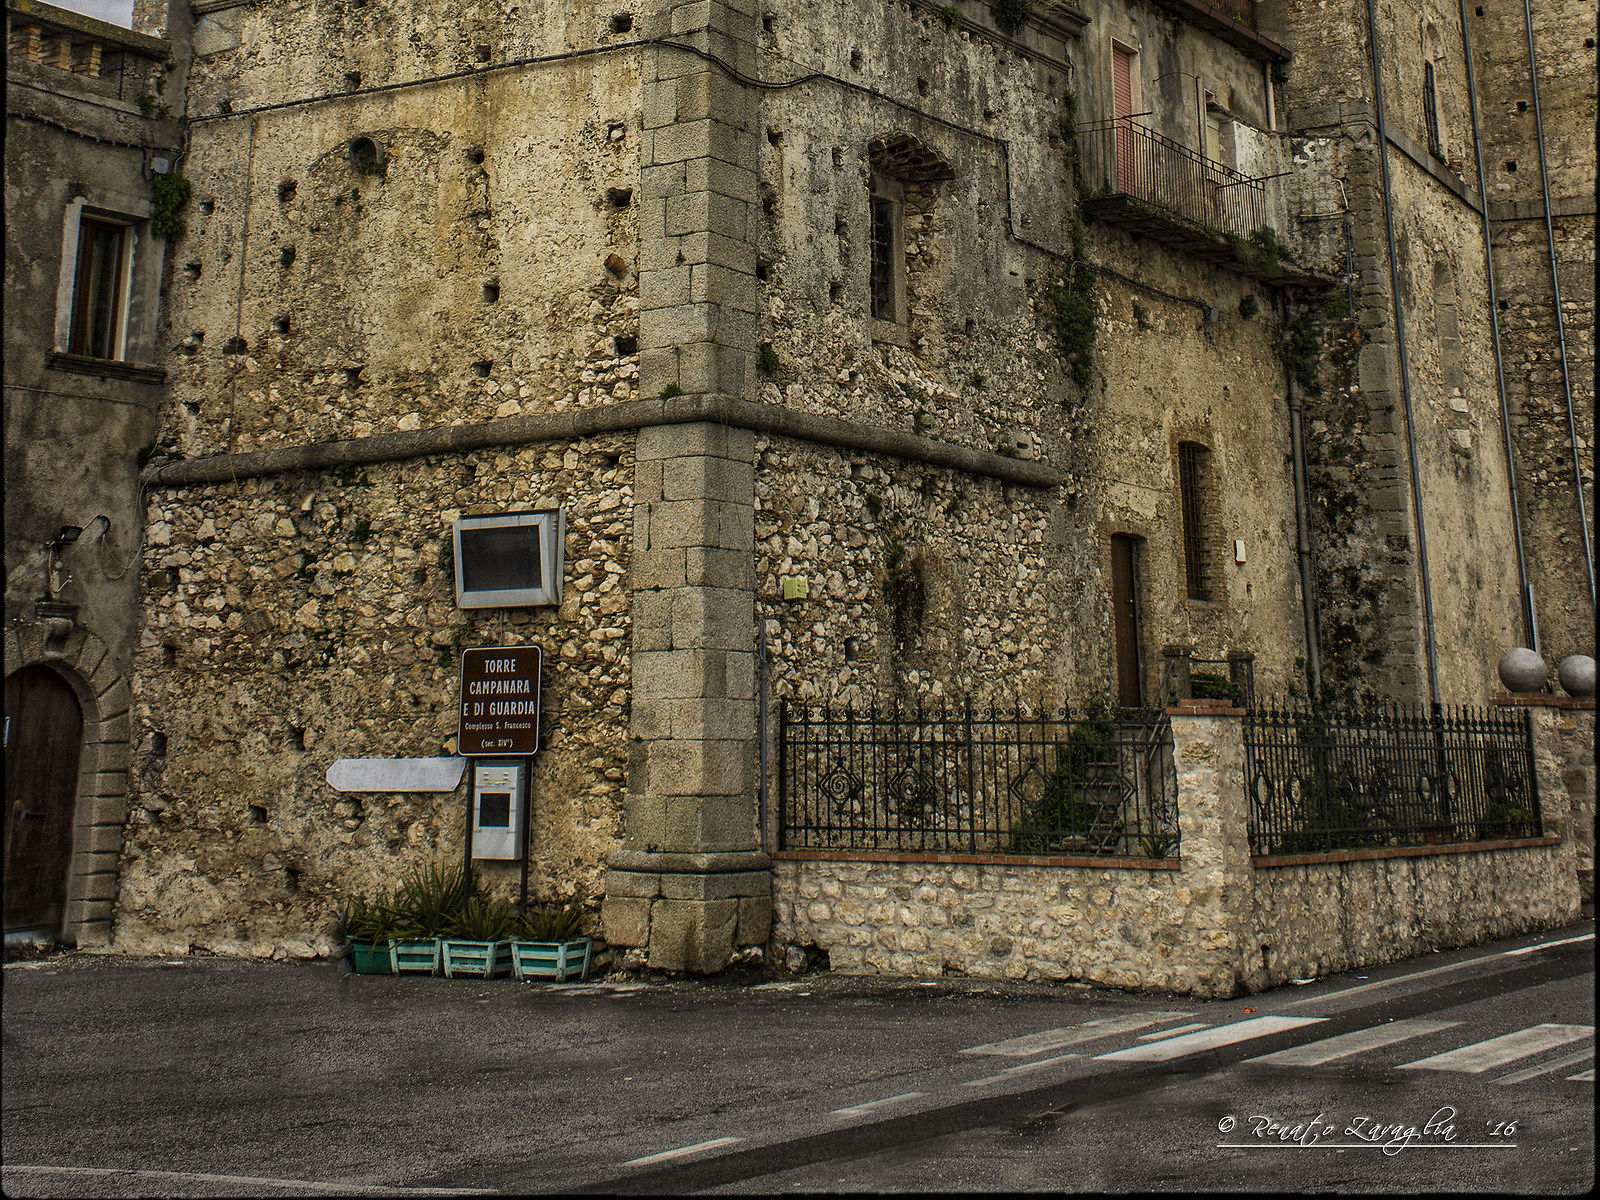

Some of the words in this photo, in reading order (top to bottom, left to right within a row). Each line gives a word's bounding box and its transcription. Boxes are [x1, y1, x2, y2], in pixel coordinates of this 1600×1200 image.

[485, 659, 516, 673] TORRE
[469, 679, 530, 695] CAMPANARA
[463, 702, 469, 717] E
[474, 702, 484, 716] DI
[489, 701, 535, 716] GUARDIA
[464, 722, 493, 730] Complesso
[496, 721, 502, 729] S.
[504, 721, 531, 729] Francesco
